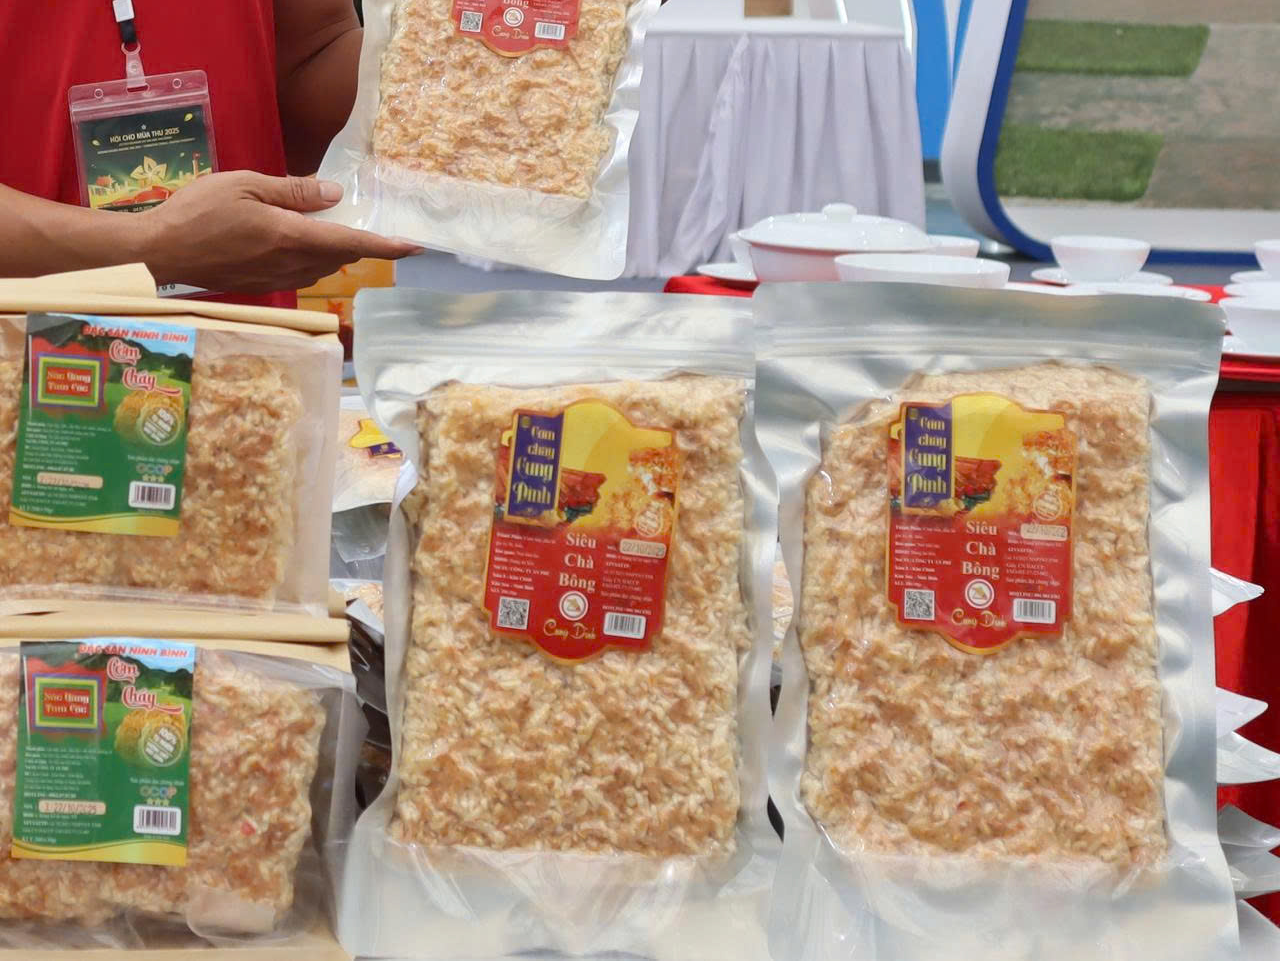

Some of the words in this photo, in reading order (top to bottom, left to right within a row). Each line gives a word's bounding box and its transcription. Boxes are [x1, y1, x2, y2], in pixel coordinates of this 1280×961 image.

[132, 328, 160, 340] NINH
[122, 366, 184, 396] Cháy
[908, 447, 946, 472] Cung
[516, 458, 555, 482] Cung
[966, 520, 998, 536] Siêu
[566, 533, 596, 548] Siêu
[966, 541, 996, 557] Chà
[564, 552, 594, 569] Chà
[559, 572, 596, 592] Bông
[130, 646, 157, 656] NINH
[122, 685, 184, 715] Cháy
